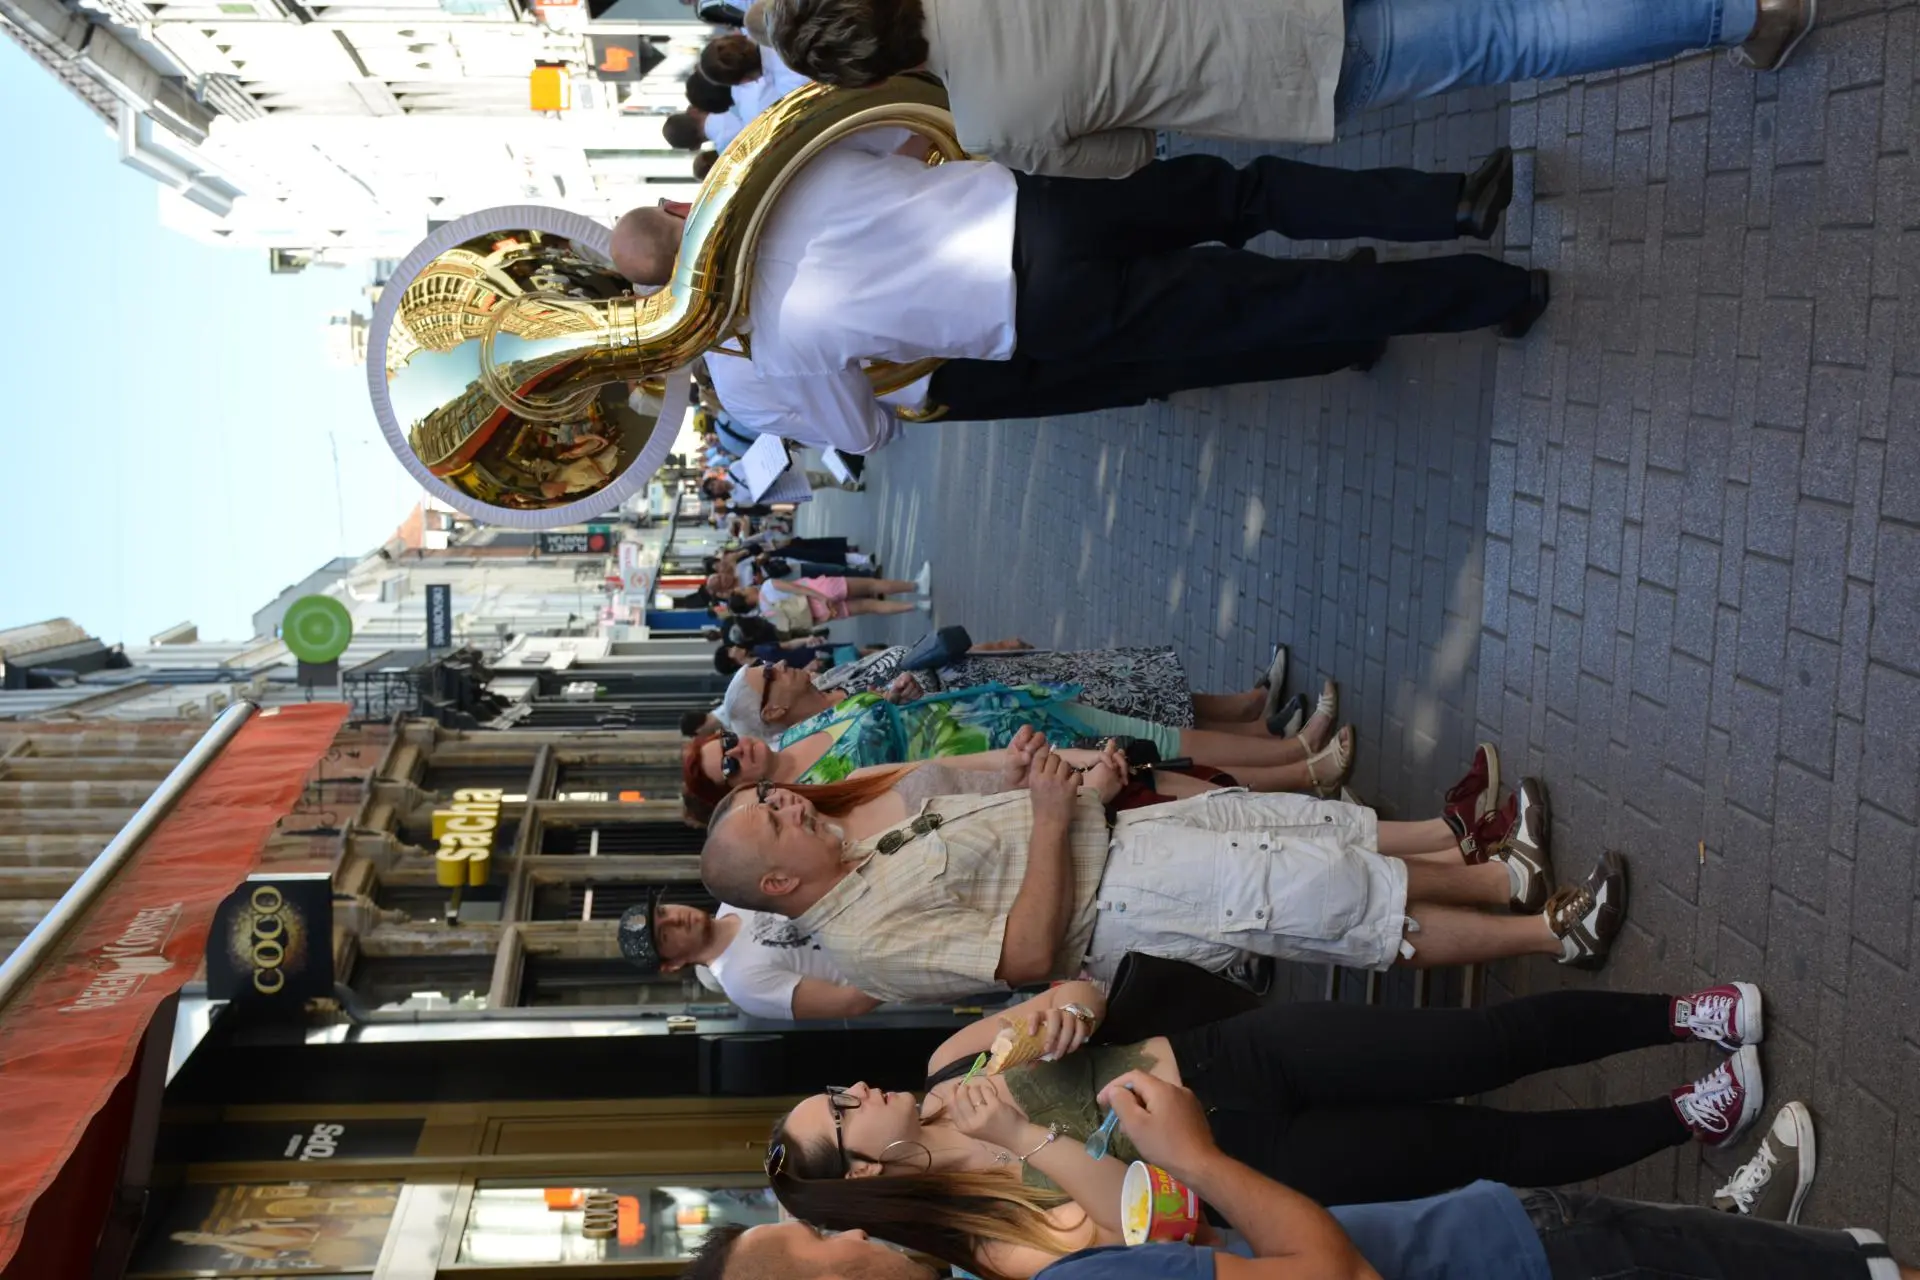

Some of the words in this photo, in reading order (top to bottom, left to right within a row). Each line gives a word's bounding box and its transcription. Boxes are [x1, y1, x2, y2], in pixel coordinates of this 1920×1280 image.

[432, 586, 446, 646] SWAROVSKI
[432, 787, 504, 862] sacha
[251, 885, 285, 994] COCO
